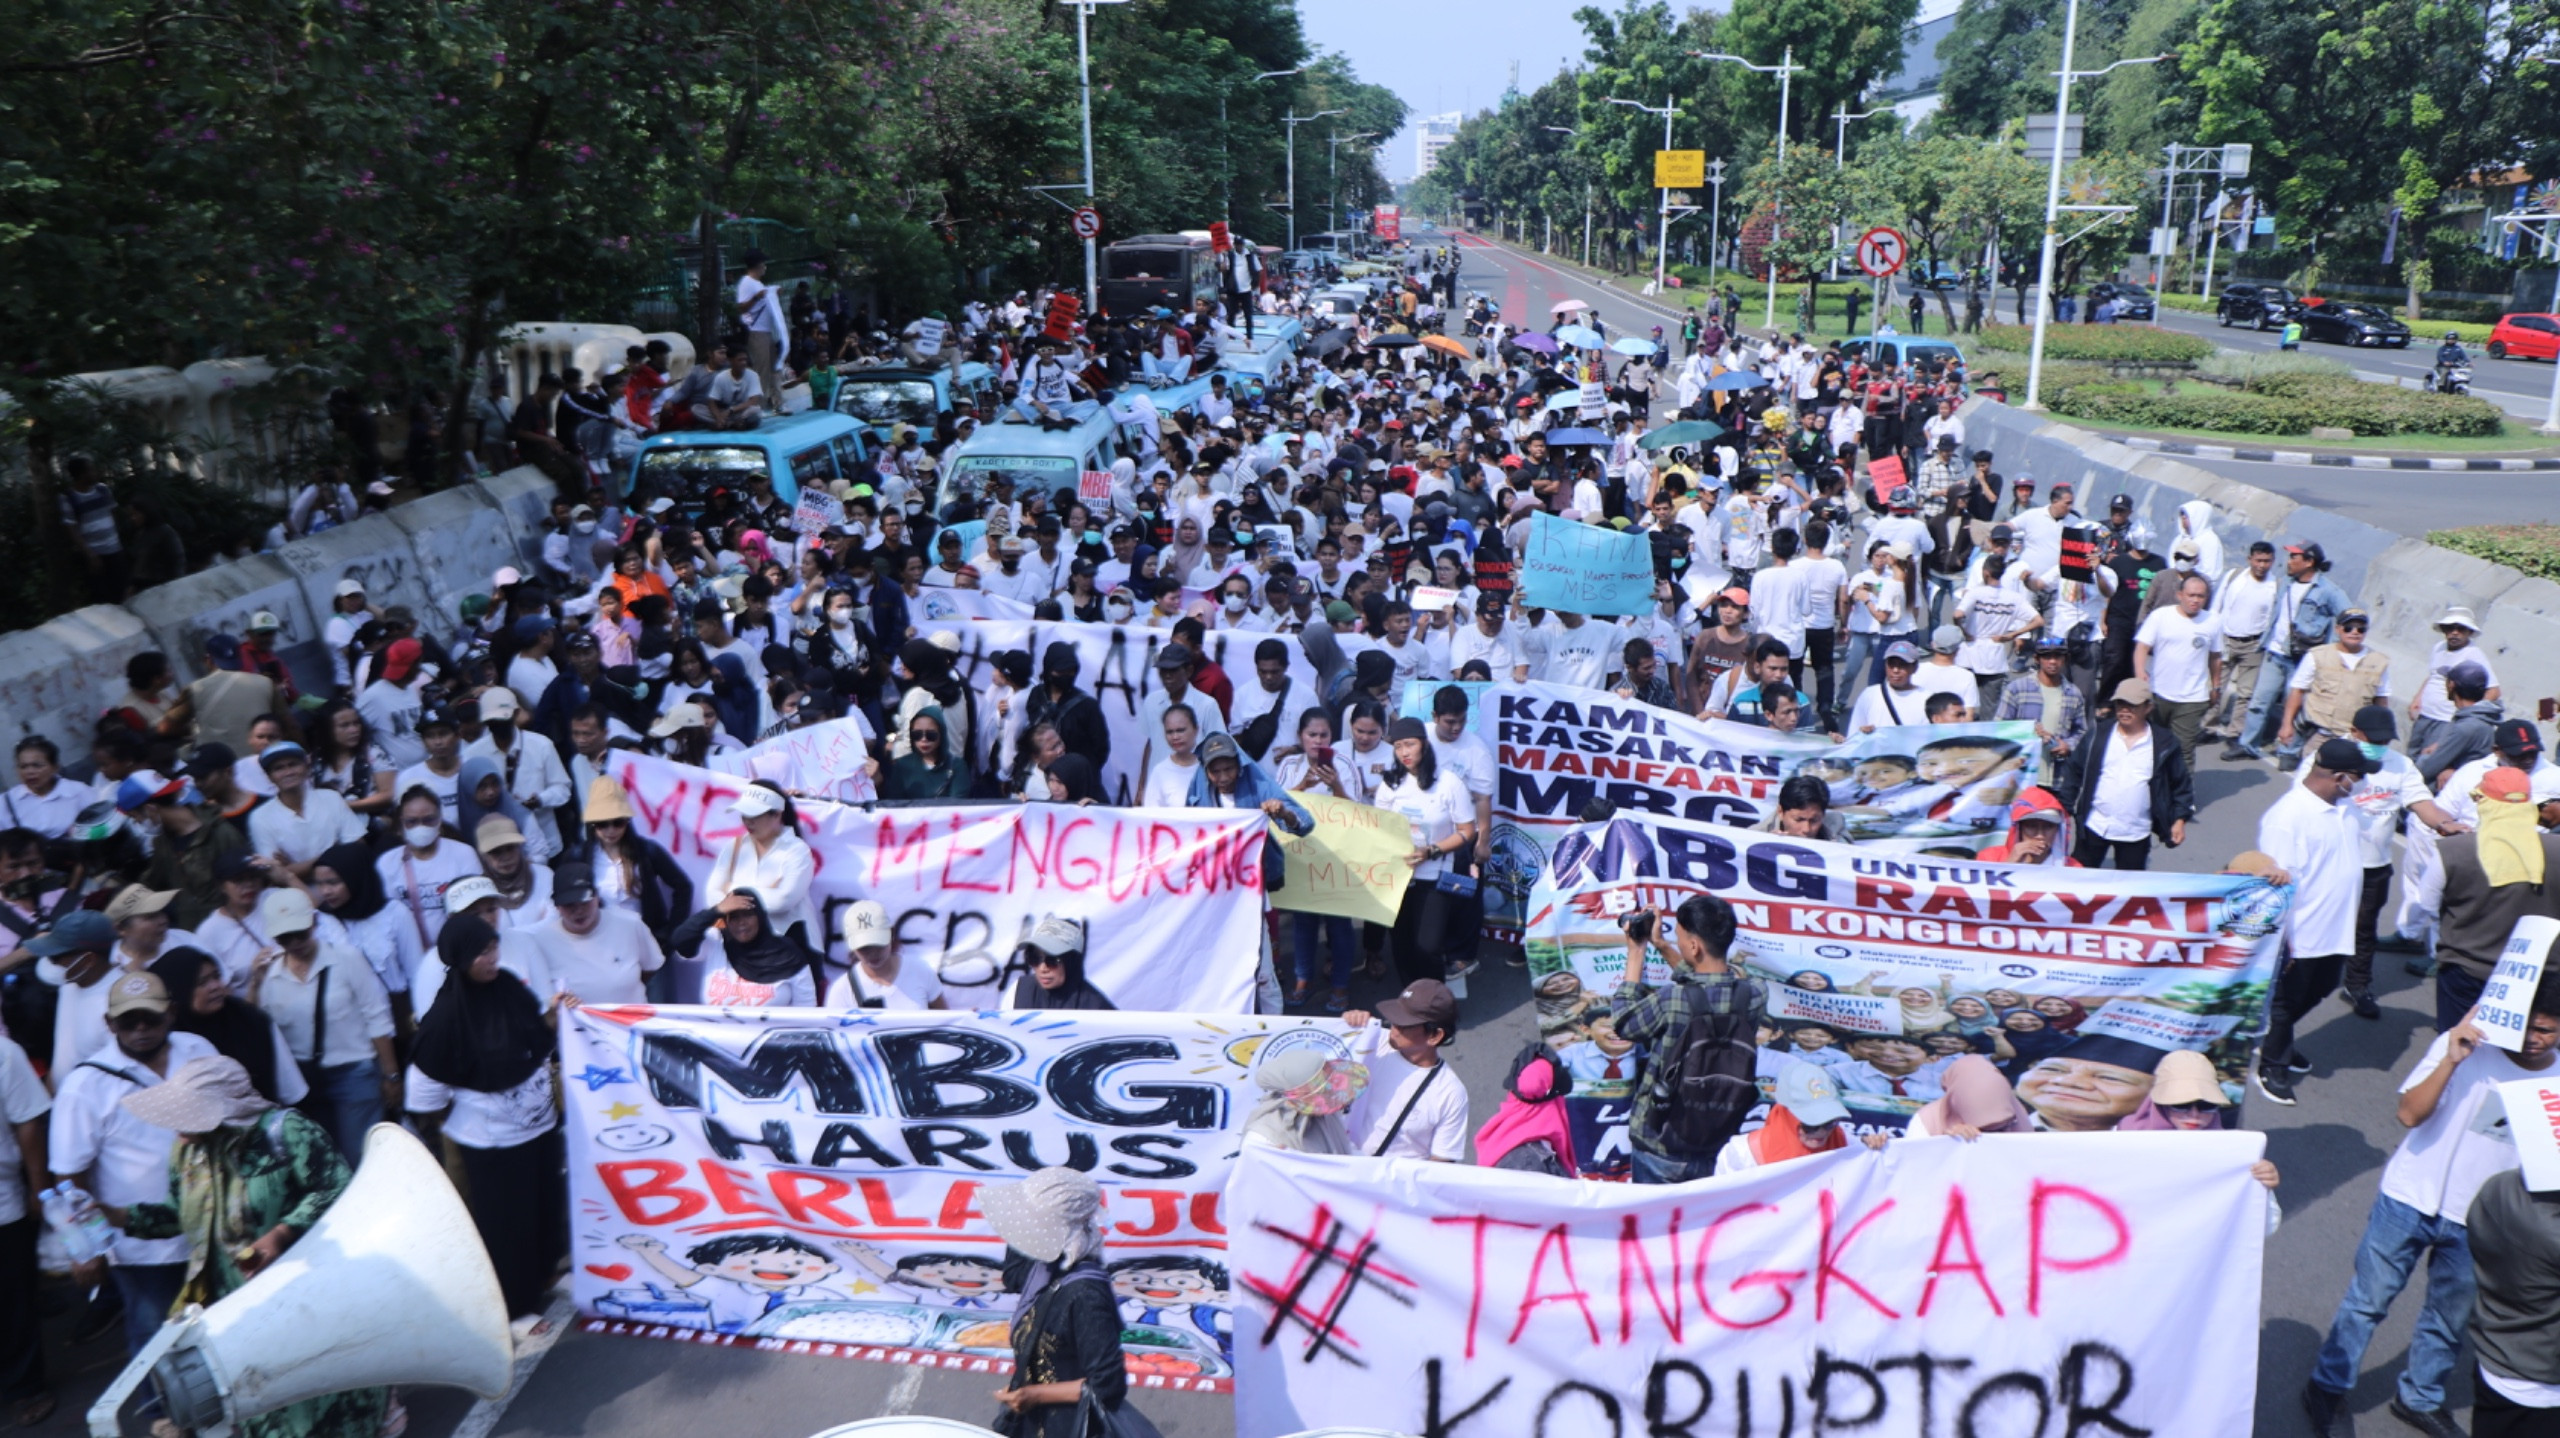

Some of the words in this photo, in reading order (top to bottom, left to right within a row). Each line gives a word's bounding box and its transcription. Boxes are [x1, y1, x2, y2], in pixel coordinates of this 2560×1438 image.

[804, 492, 828, 507] MBG
[1081, 471, 1112, 499] MBG
[1560, 578, 1618, 601] MBG
[1499, 695, 1668, 736] KAMI
[1498, 744, 1779, 799] MANFAAT
[1499, 721, 1782, 777] RASAKAN
[1499, 767, 1760, 826] MBG
[1309, 860, 1394, 893] MBG
[1552, 818, 1828, 901] MBG
[1851, 857, 2016, 887] UNTUK
[1602, 889, 1770, 928] BUKN
[1790, 910, 2216, 965] KONGLOMERAT
[1855, 876, 2225, 933] RAKYAT
[1860, 949, 1916, 960] Makanan
[1783, 988, 1822, 1002] MBG
[1828, 997, 1885, 1010] UNTUK
[642, 1028, 1226, 1129] MBG
[700, 1116, 1198, 1180] HARUS
[1237, 1178, 2131, 1368] #TANGKAP
[586, 1319, 735, 1346] ALIANSI
[757, 1336, 1014, 1374] MASYARAKAT
